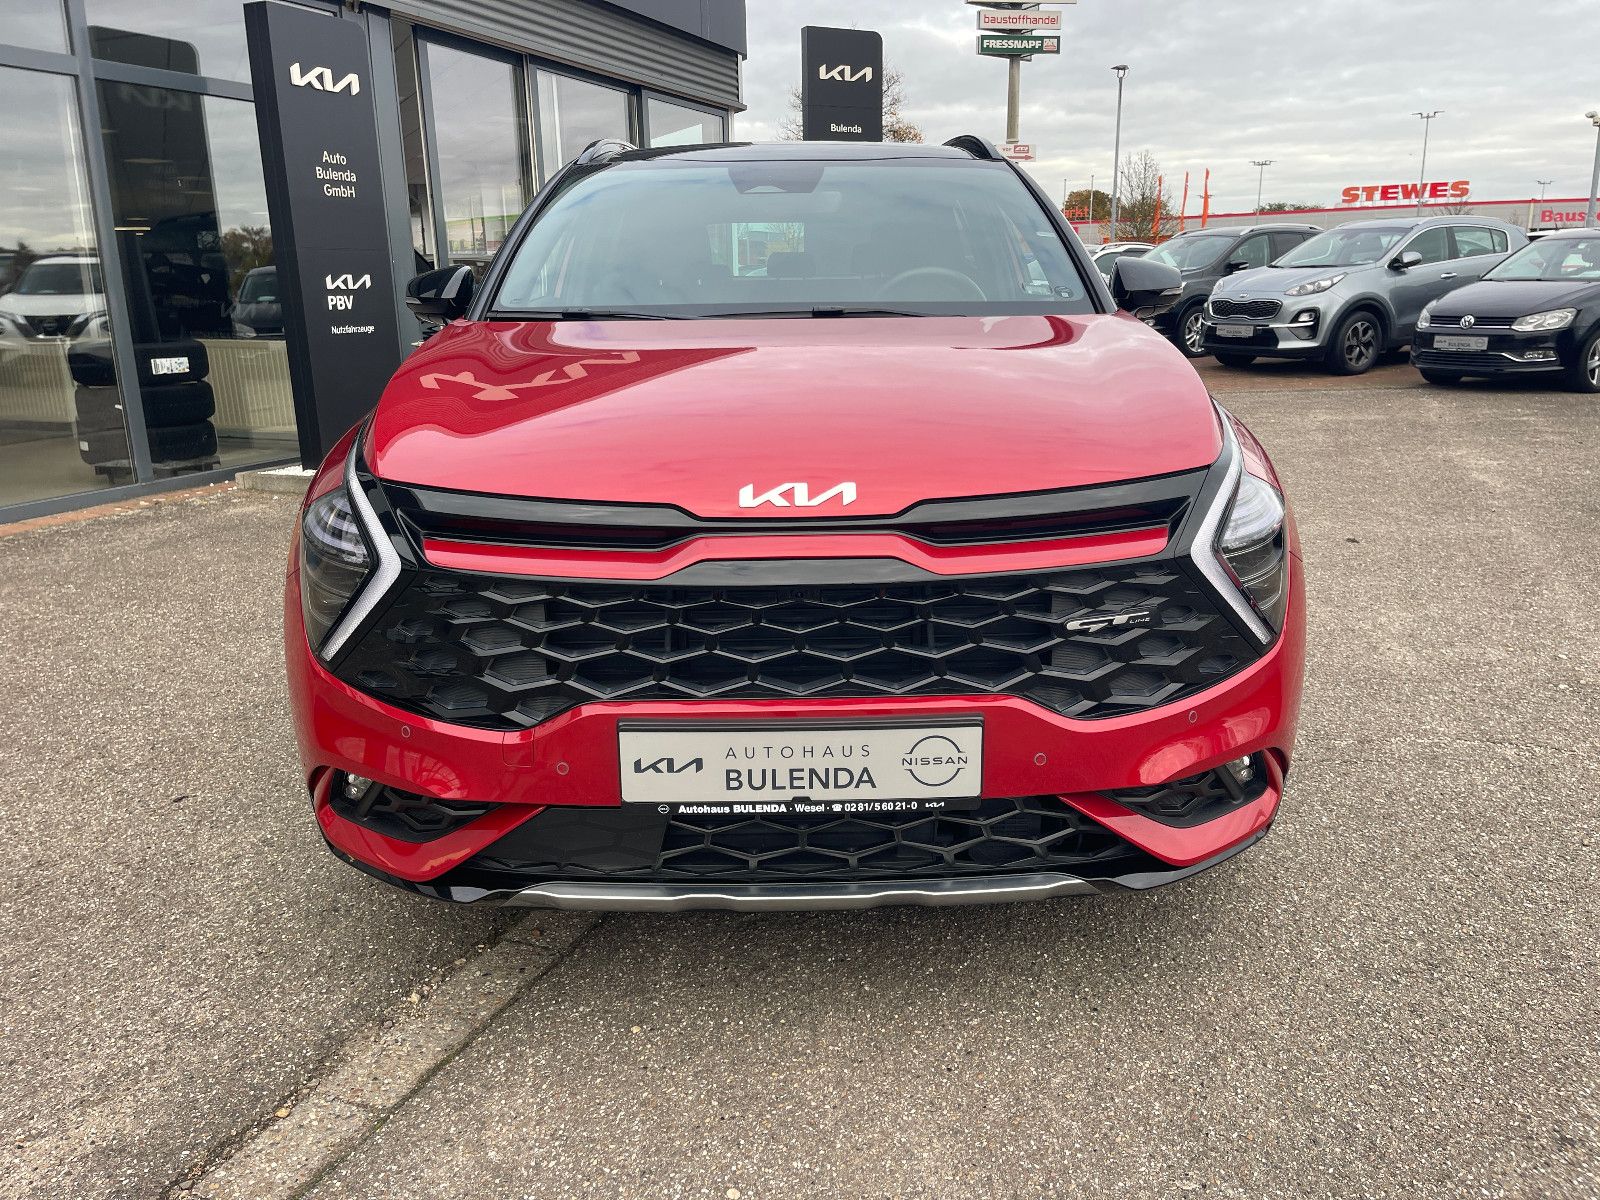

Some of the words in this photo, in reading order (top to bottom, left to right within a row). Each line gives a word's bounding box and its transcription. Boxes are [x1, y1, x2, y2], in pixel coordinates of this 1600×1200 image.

[983, 14, 1059, 25] baustoffhandel
[983, 39, 1042, 49] FRESSNAPF
[289, 62, 360, 96] KIA
[819, 63, 873, 83] KIA
[830, 123, 862, 134] Bulenda
[322, 150, 347, 166] Auto
[315, 166, 357, 183] Bulenda
[323, 183, 356, 198] GmbH
[1342, 180, 1470, 204] STEWES
[1060, 206, 1089, 219] arkt
[1541, 209, 1600, 223] Baus
[325, 274, 372, 290] KIA
[328, 295, 354, 311] PBV
[331, 324, 375, 336] Nutzfahrzeuge
[738, 481, 857, 508] KIA
[725, 744, 870, 760] AUTOHAUS
[633, 757, 703, 774] KIA
[902, 755, 968, 767] NISSAN
[725, 766, 877, 791] BULENDA
[678, 805, 730, 814] Autohaus
[733, 804, 787, 813] BULENDA
[794, 803, 825, 812] Wesel
